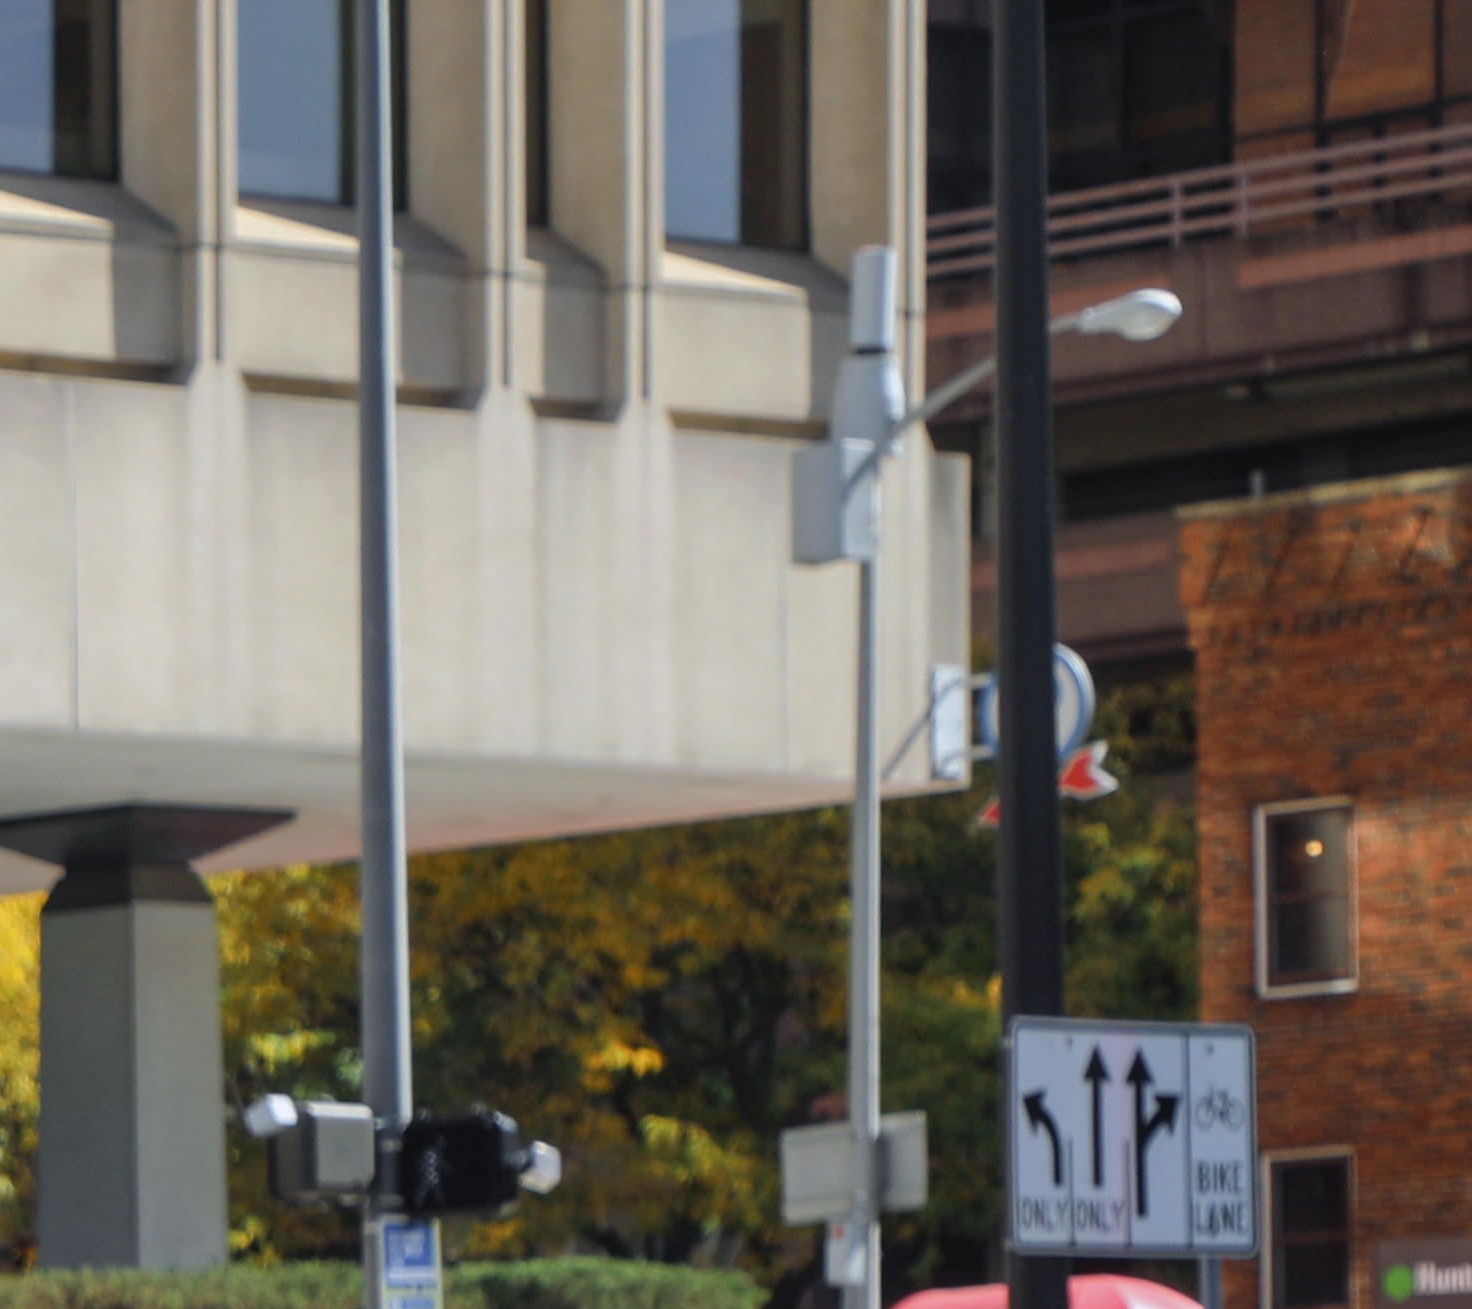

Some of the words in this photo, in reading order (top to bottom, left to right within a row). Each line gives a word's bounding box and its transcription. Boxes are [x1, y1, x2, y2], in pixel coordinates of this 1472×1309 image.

[1196, 1160, 1243, 1194] BIKE
[1020, 1199, 1070, 1233] ONLY
[1075, 1200, 1126, 1234] ONLY
[1196, 1201, 1245, 1236] LANE
